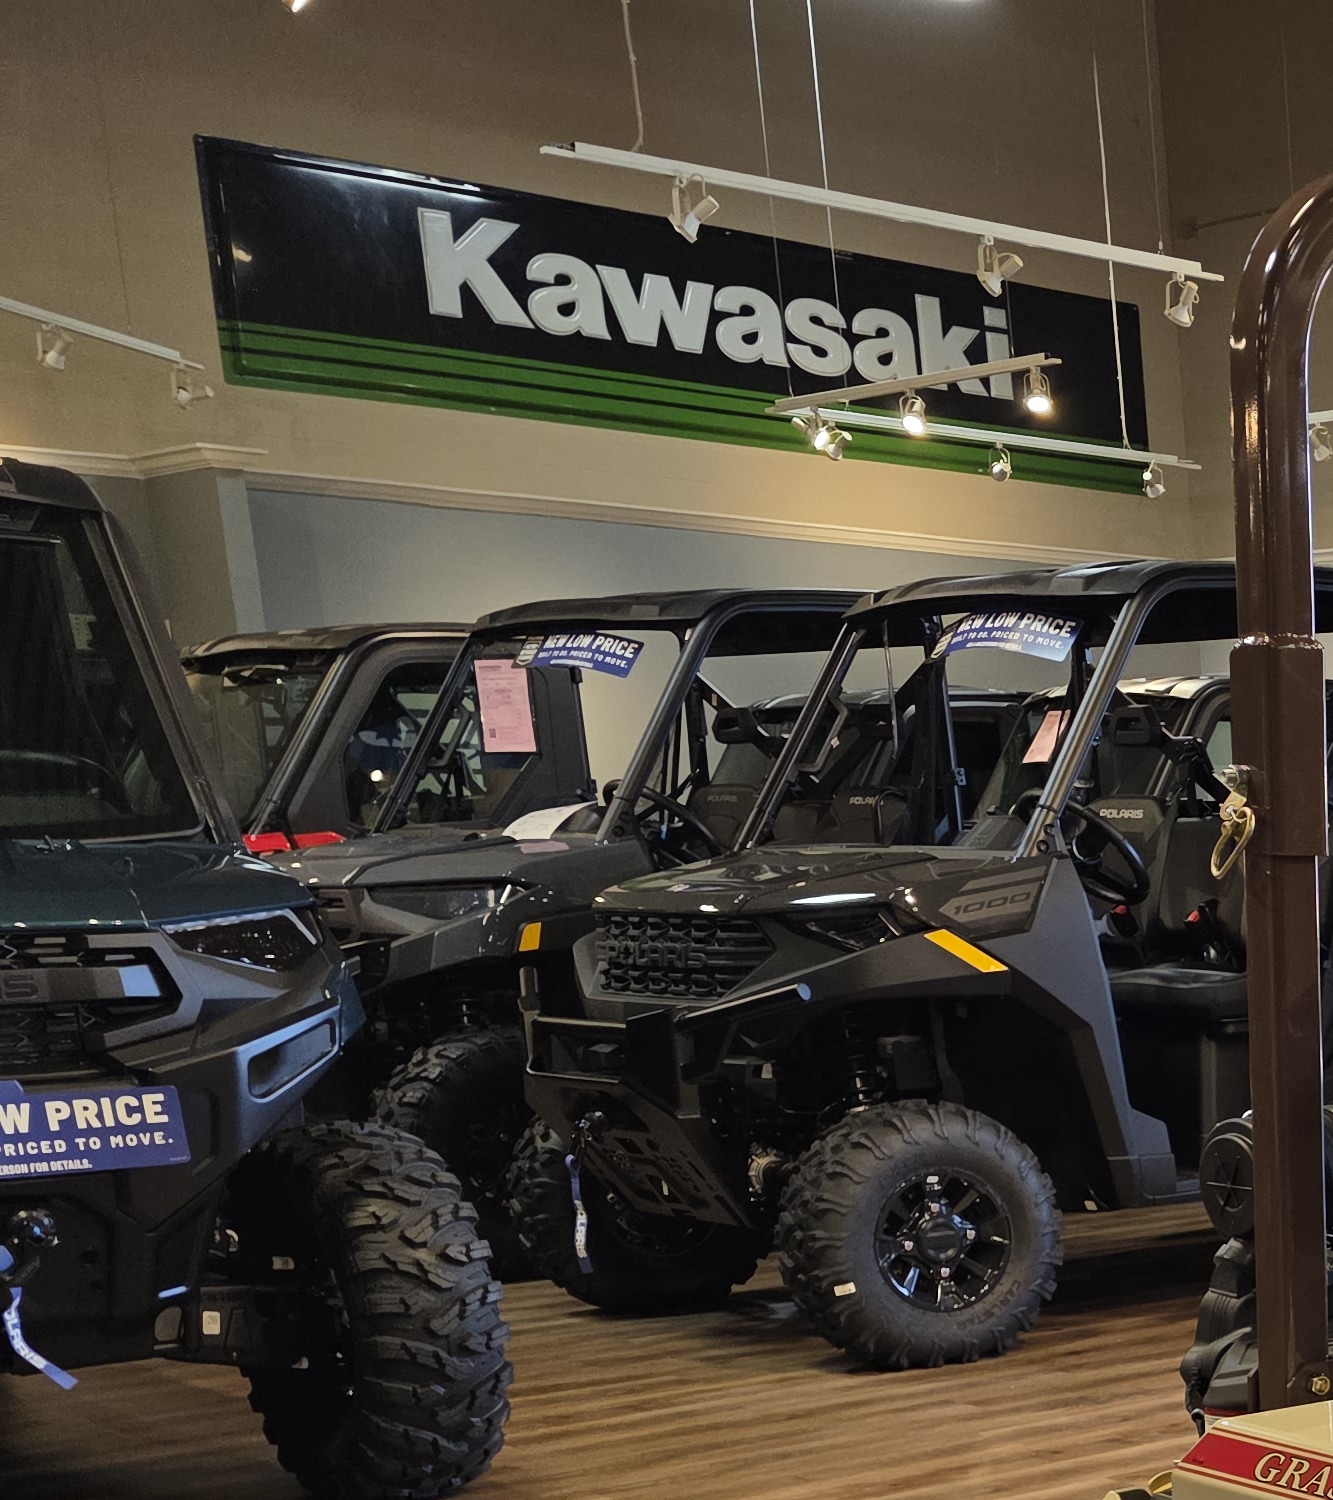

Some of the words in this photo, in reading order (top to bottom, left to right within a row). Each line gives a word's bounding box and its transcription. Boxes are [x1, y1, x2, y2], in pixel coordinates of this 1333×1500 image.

[417, 207, 1014, 400] Kawasaki
[957, 613, 988, 633] NEW
[985, 612, 1021, 628] LOW
[1018, 613, 1076, 638] PRICE
[543, 635, 570, 649] NEW
[566, 635, 594, 648] LOW
[592, 636, 639, 658] PRICE
[991, 631, 1020, 640] PRICED
[1023, 633, 1034, 642] TO
[1035, 636, 1064, 649] MOVE.
[571, 650, 592, 658] PRICED
[594, 653, 603, 661] TO
[604, 655, 628, 668] MOVE.
[1100, 808, 1144, 819] POLARIS
[954, 891, 1032, 916] 1000
[45, 1093, 169, 1132] PRICE
[0, 1139, 67, 1157] RICED
[75, 1136, 101, 1151] TO
[110, 1131, 174, 1149] MOVE.
[30, 1161, 49, 1173] FOR
